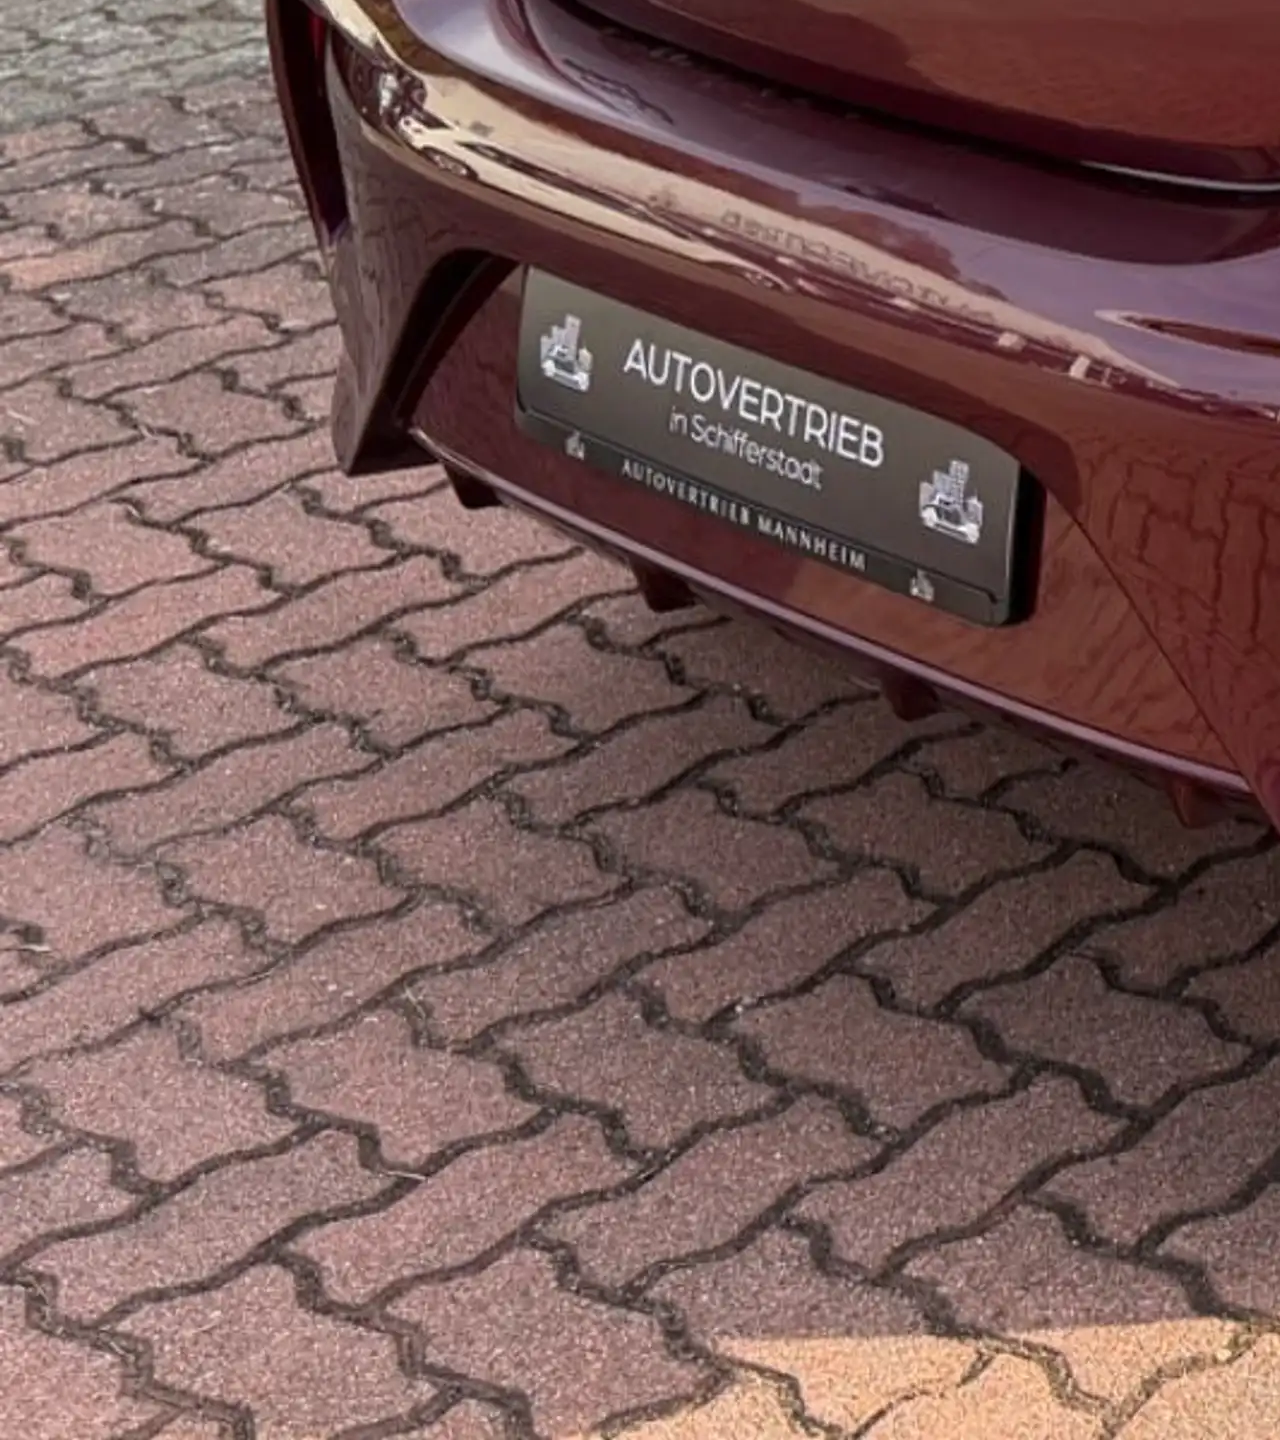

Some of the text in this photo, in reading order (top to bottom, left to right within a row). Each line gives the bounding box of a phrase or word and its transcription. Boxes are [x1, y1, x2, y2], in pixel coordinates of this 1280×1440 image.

[623, 337, 885, 468] AUTOVERTRIEB
[669, 405, 824, 492] in Schifferstadt
[621, 458, 867, 573] AUTOVERTRIEB MANNHEIM
